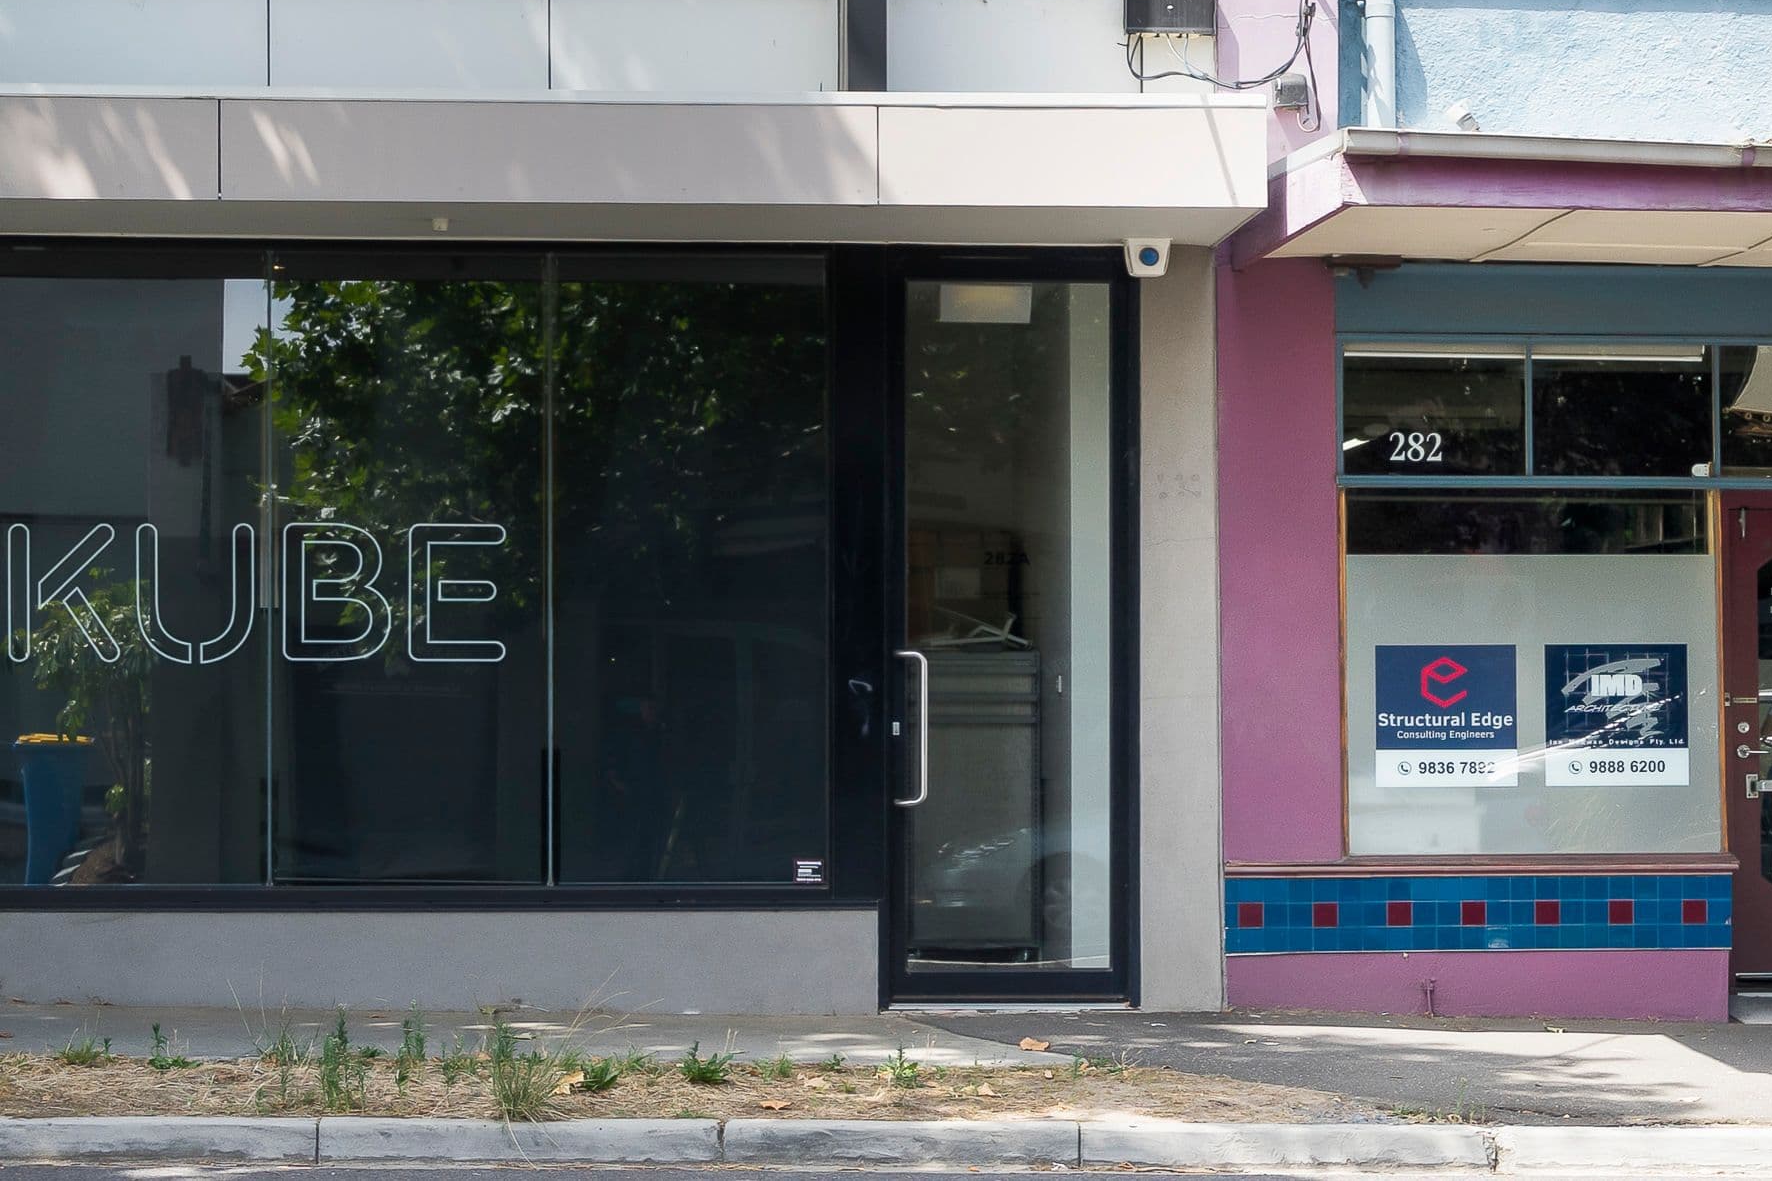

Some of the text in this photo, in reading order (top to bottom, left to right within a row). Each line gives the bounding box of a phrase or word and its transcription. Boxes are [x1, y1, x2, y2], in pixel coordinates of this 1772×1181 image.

[1388, 431, 1443, 462] 282
[7, 523, 506, 665] KUBE
[1591, 674, 1643, 697] IMD
[1377, 712, 1514, 730] Structural Edge
[1396, 730, 1495, 741] Consulting Engineers
[1418, 761, 1455, 775] 9836
[1589, 760, 1666, 774] 9888 6200
